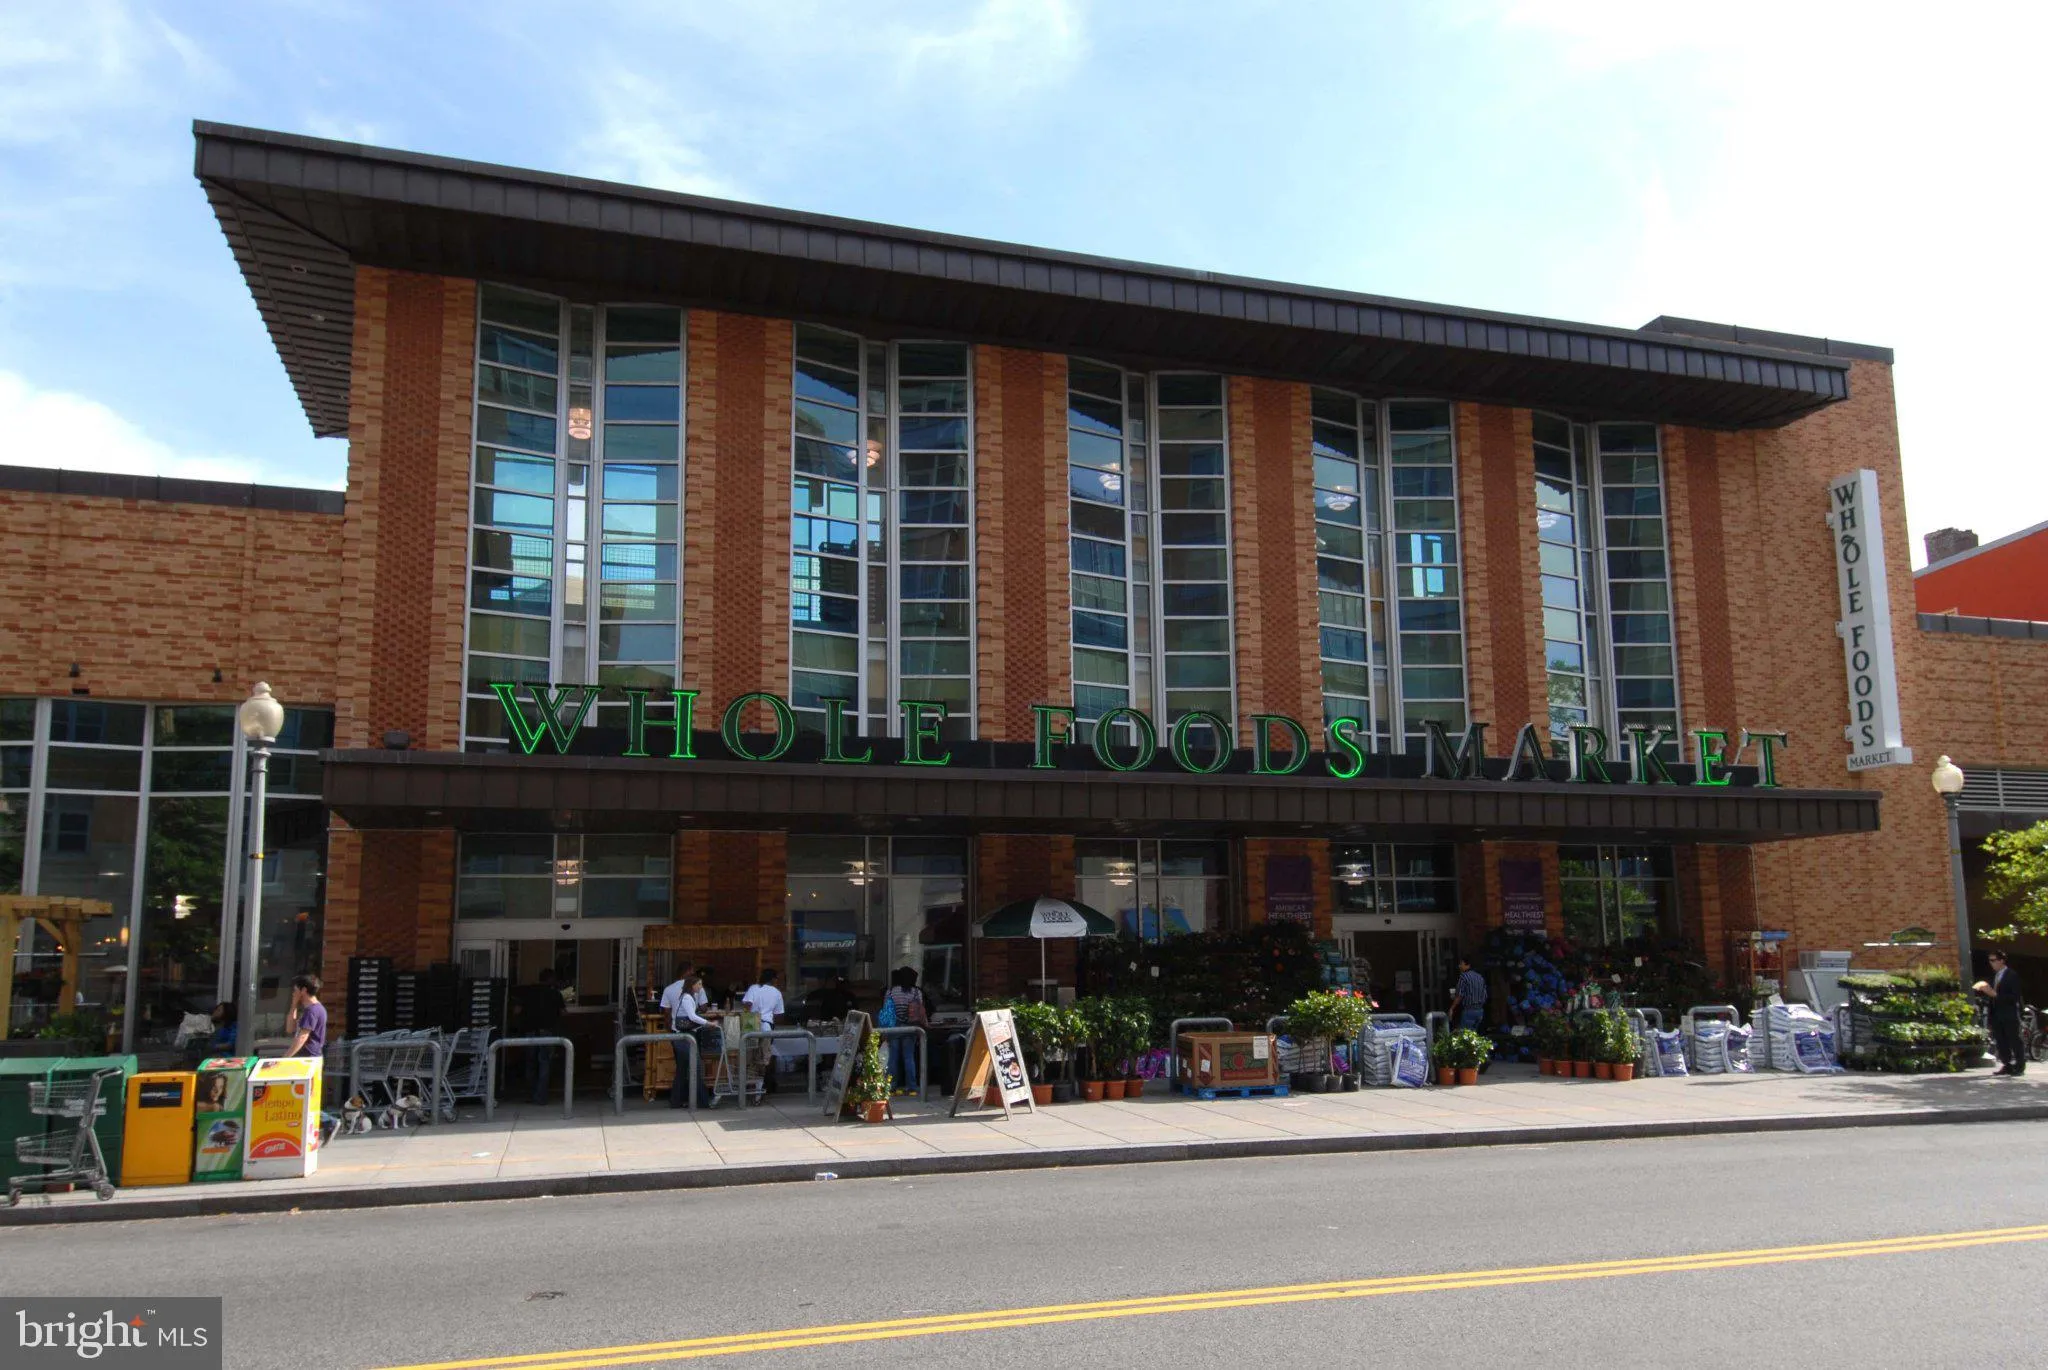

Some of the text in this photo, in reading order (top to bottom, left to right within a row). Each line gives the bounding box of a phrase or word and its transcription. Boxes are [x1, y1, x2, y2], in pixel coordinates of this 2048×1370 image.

[1834, 481, 1874, 748] WHOLE FOODS
[489, 682, 1788, 788] WHOLE FOODS MARKET
[1849, 751, 1892, 768] MARKET
[1504, 911, 1545, 919] HEALTHIEST
